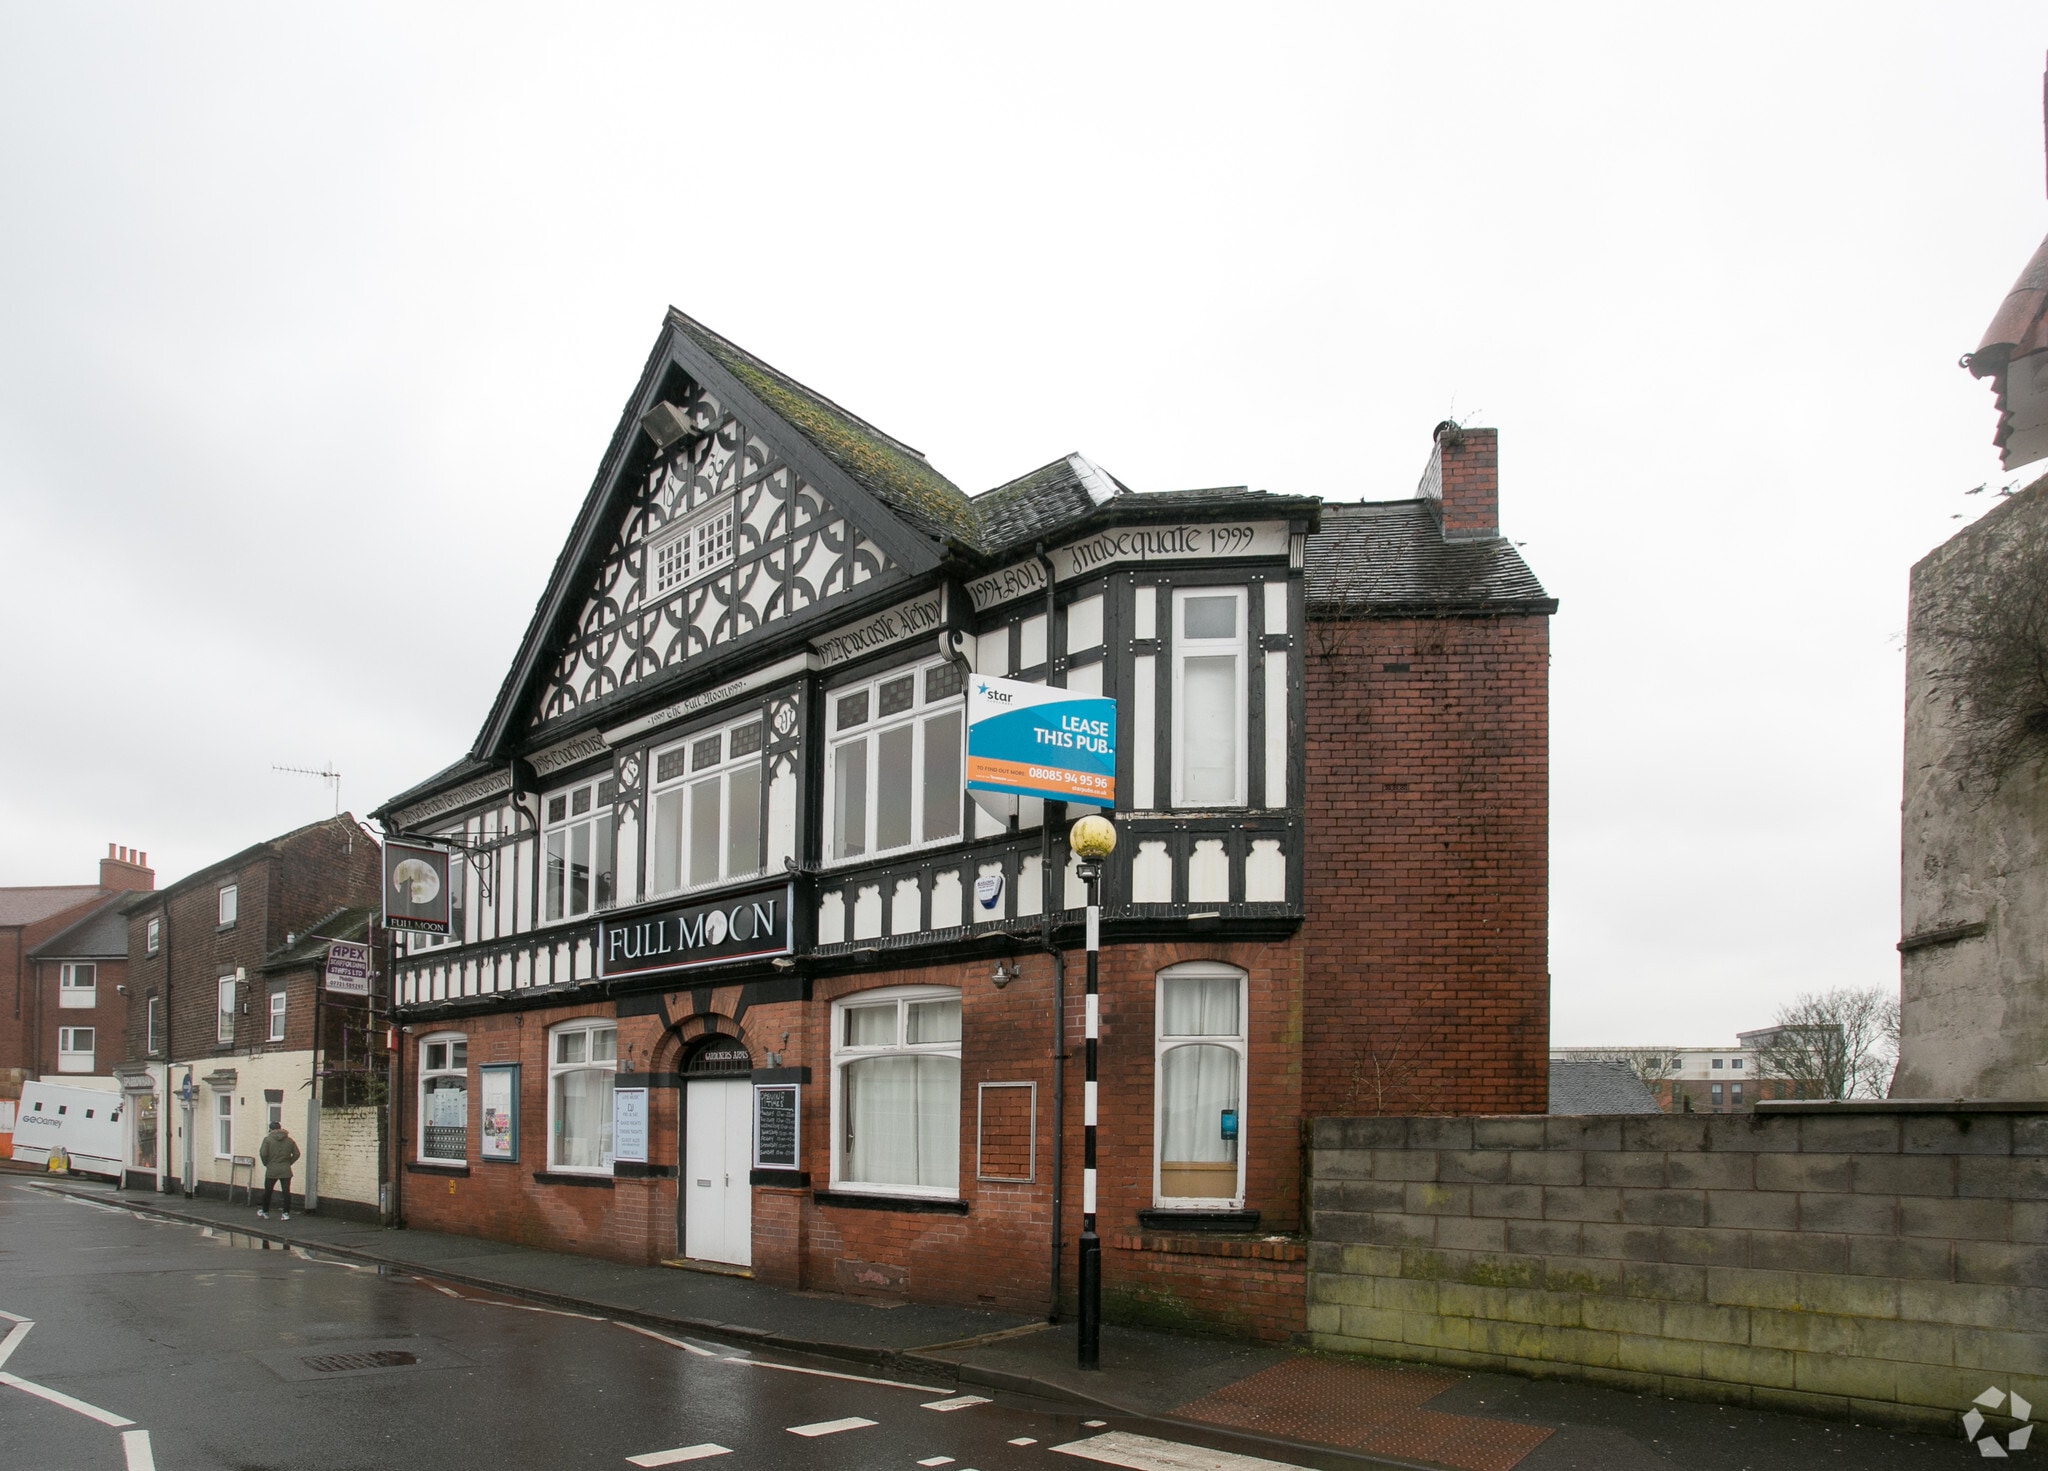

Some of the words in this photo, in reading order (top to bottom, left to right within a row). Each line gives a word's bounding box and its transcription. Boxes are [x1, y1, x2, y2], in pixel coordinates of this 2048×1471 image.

[970, 578, 1002, 606] 1994
[1062, 526, 1201, 574] Inadequate
[1208, 527, 1254, 554] 1999
[988, 690, 1013, 702] star
[1062, 715, 1109, 737] LEASE
[1034, 728, 1073, 748] THIS
[1076, 735, 1113, 754] PUB.
[1029, 767, 1062, 782] 08085
[1064, 772, 1078, 784] 94
[1080, 775, 1092, 786] 95
[1094, 778, 1107, 789] 96
[391, 918, 412, 928] FULL
[415, 922, 444, 932] MOON
[609, 920, 671, 962] FULL
[678, 900, 775, 950] MOON
[333, 945, 365, 960] APEX
[330, 959, 365, 969] SCAFFOLDING
[331, 967, 352, 975] STAFFS
